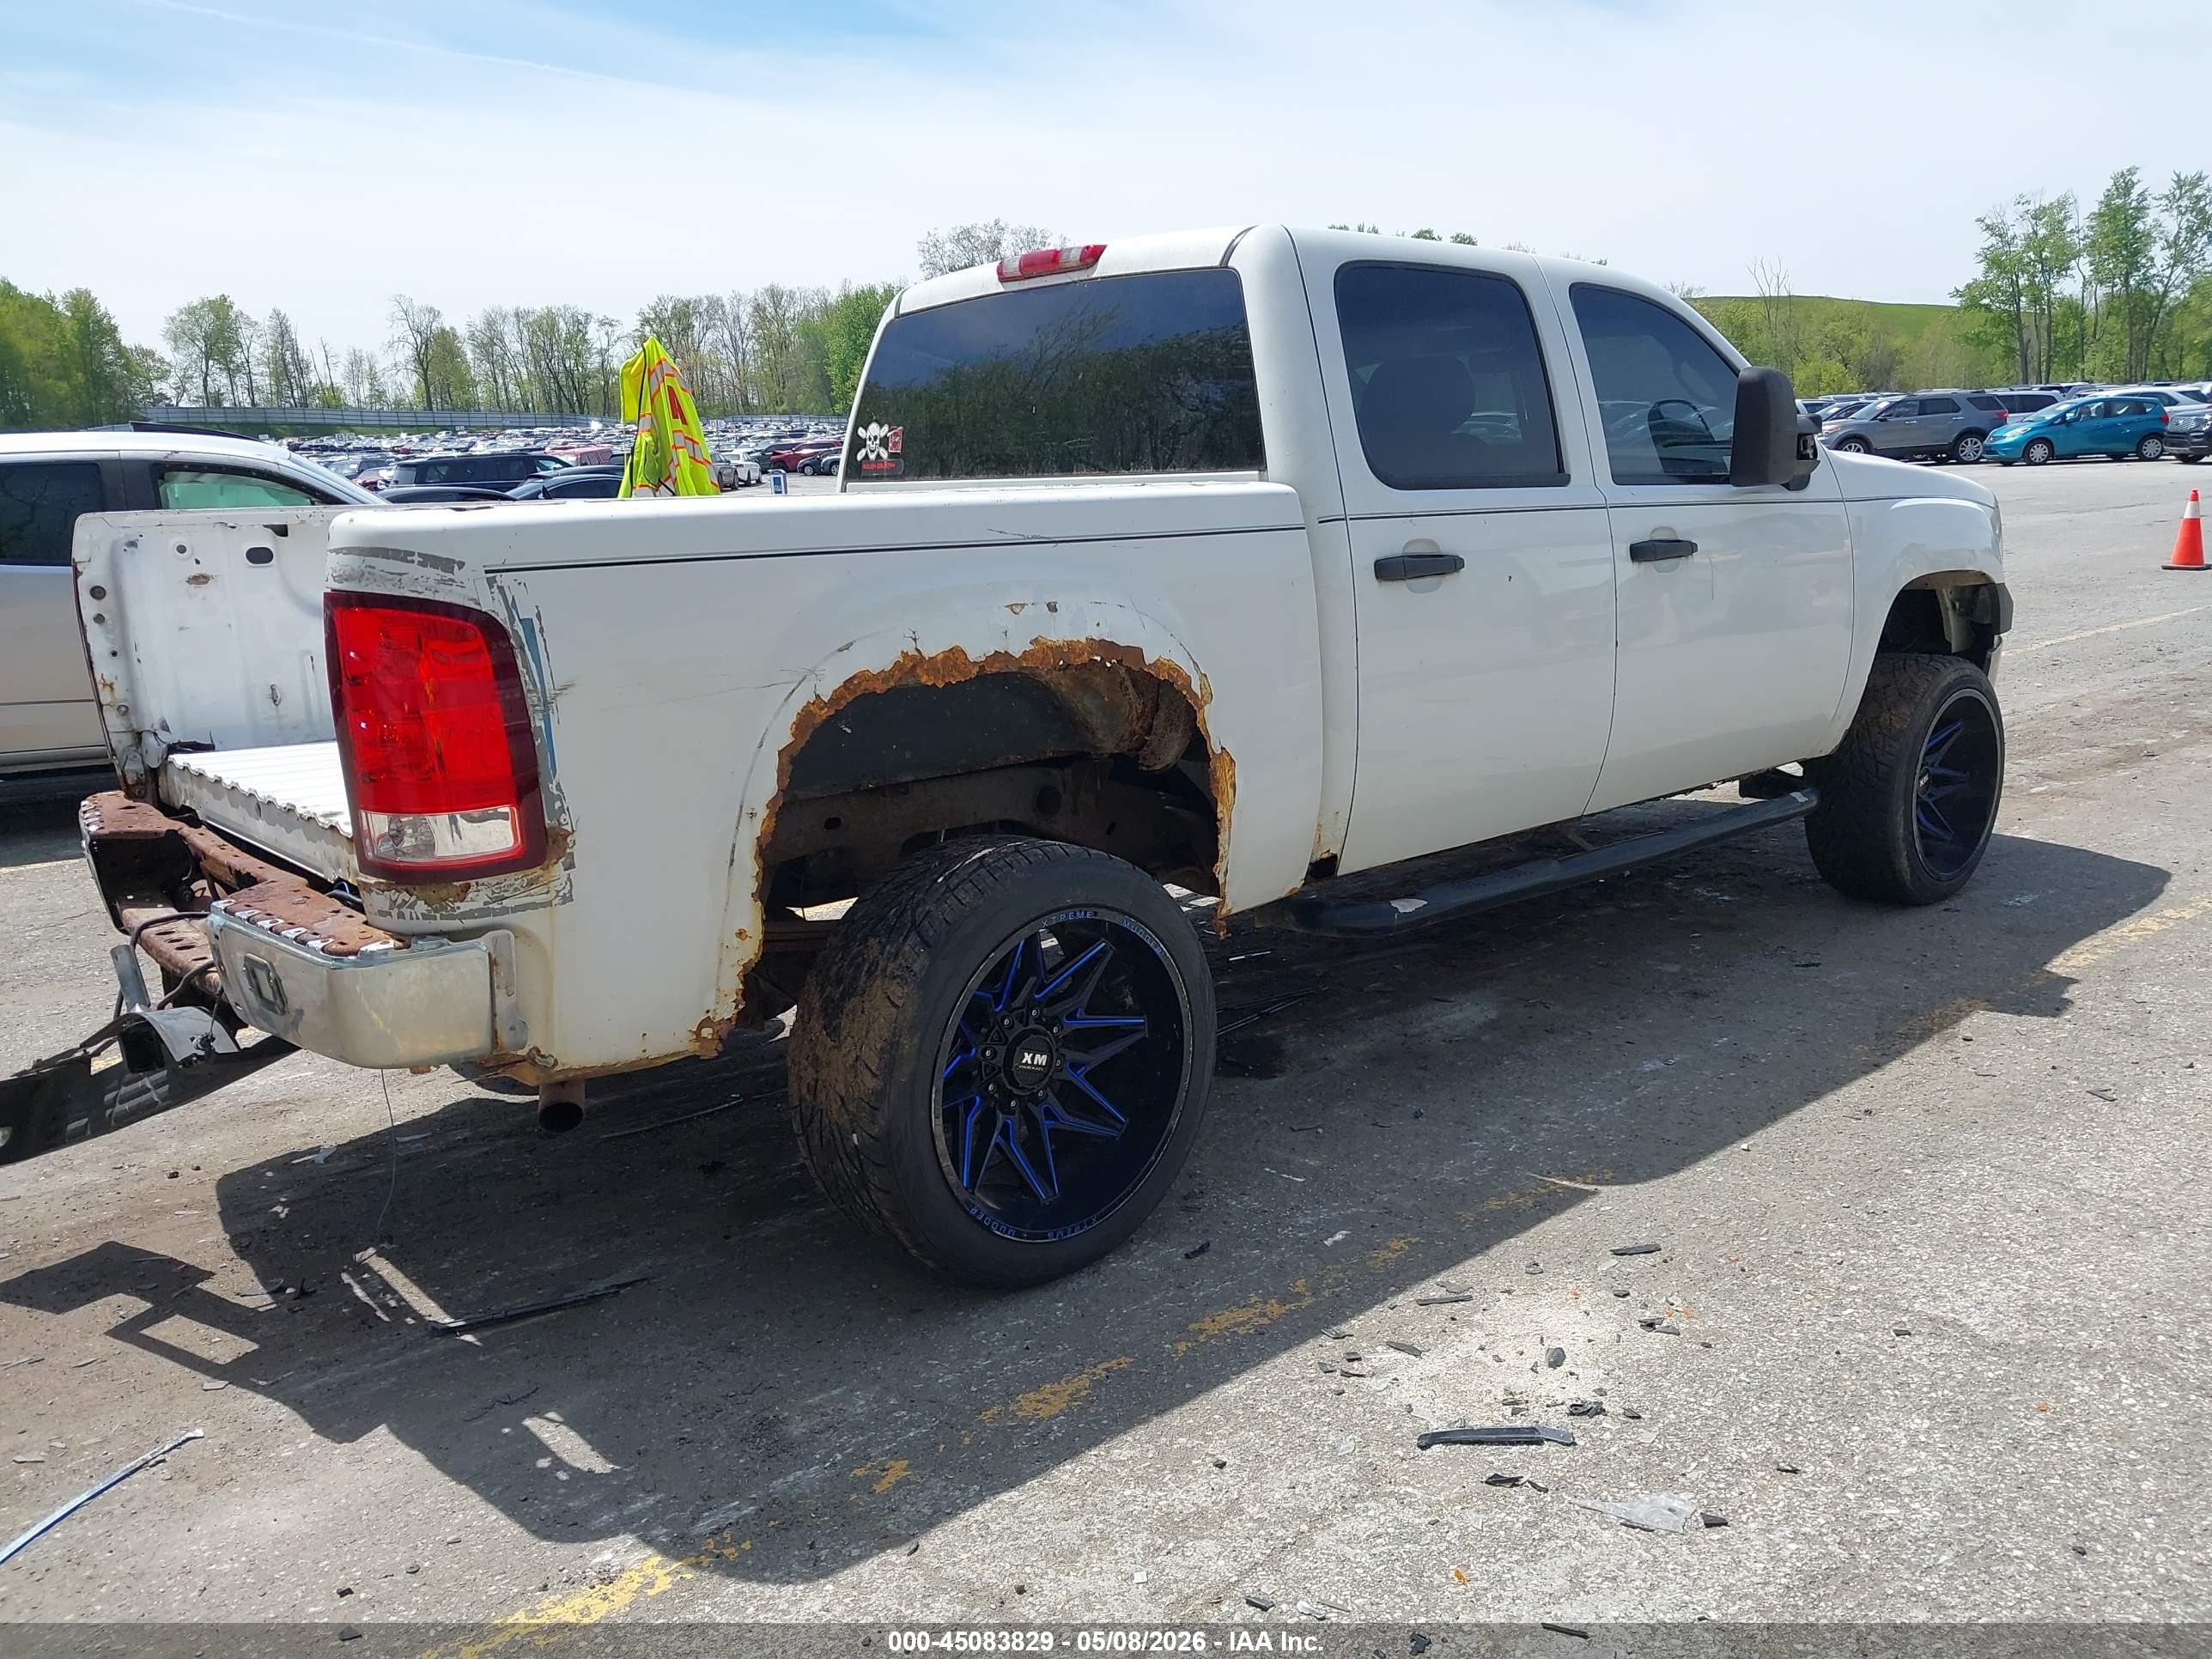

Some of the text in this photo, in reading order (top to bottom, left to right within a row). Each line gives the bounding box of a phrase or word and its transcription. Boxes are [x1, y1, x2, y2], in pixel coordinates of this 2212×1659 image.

[1042, 911, 1164, 956] XTREME MUDDER
[1021, 1052, 1048, 1066] XM
[969, 1205, 1016, 1237] MUDDER
